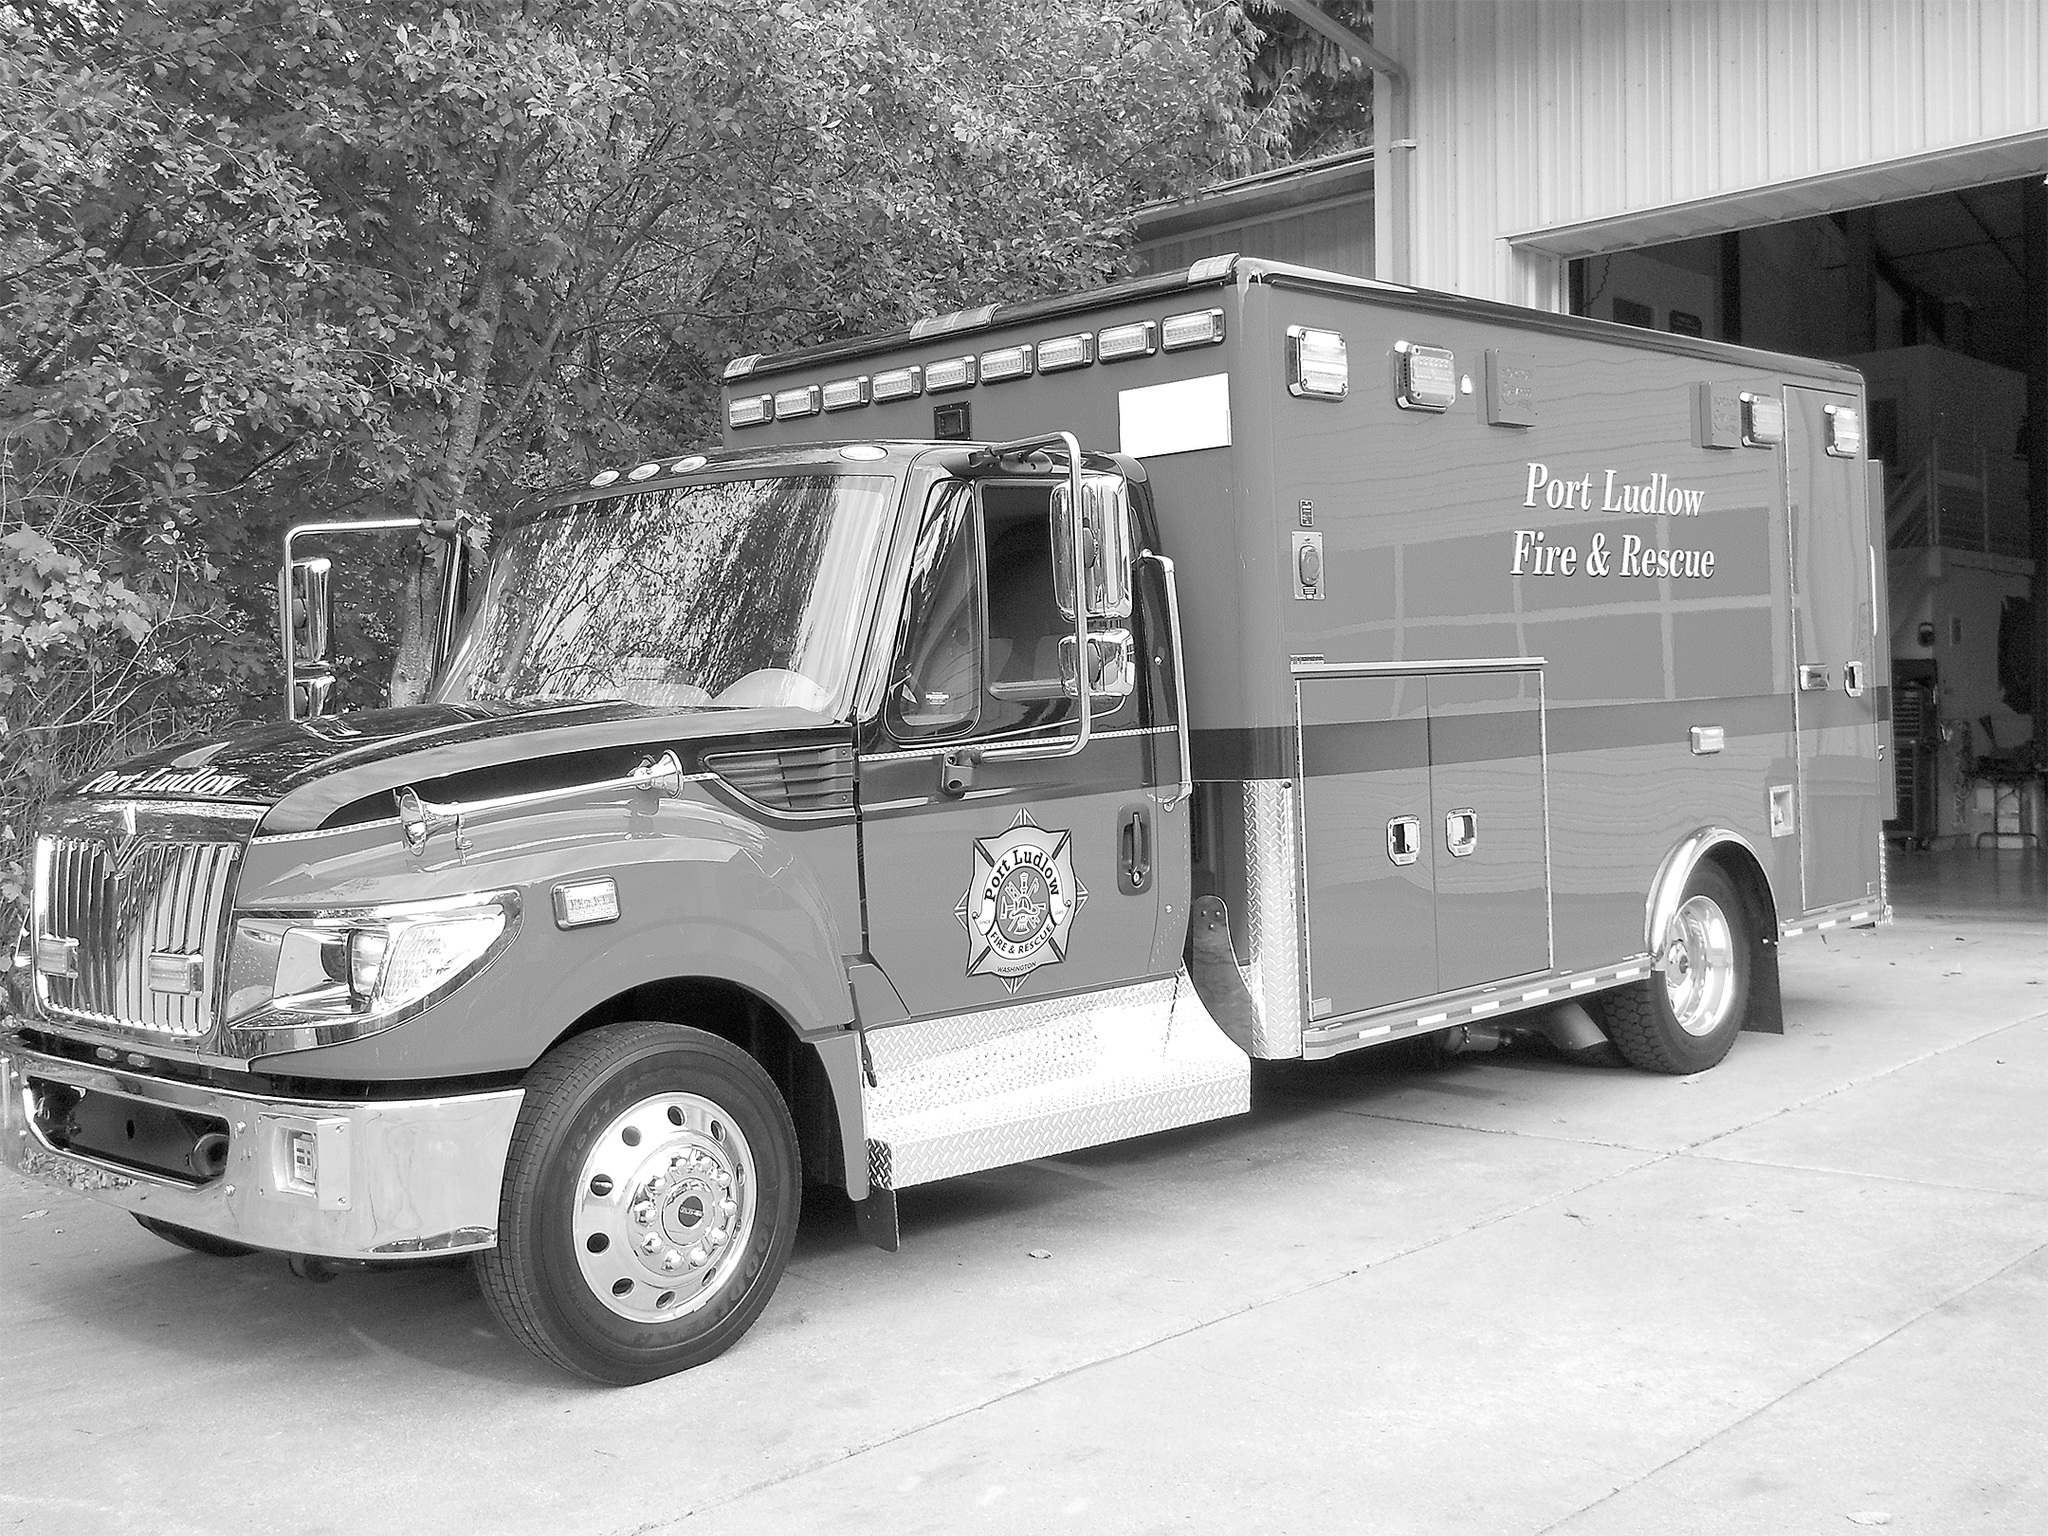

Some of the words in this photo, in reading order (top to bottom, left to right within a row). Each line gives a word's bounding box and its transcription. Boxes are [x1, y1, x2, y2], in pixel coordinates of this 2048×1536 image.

[1522, 462, 1593, 511] Port
[1601, 469, 1705, 517] Ludlow
[1510, 530, 1577, 576] Fire
[1586, 532, 1611, 577] &
[1619, 534, 1716, 578] Rescue
[77, 770, 148, 795] Port
[132, 767, 249, 796] Ludlow
[984, 859, 1010, 902] Port
[1012, 849, 1059, 896] Ludlow
[990, 931, 1008, 952] FIRE
[1008, 945, 1015, 954] &
[1017, 924, 1053, 954] RESCUE
[997, 961, 1037, 972] WASHINGTON
